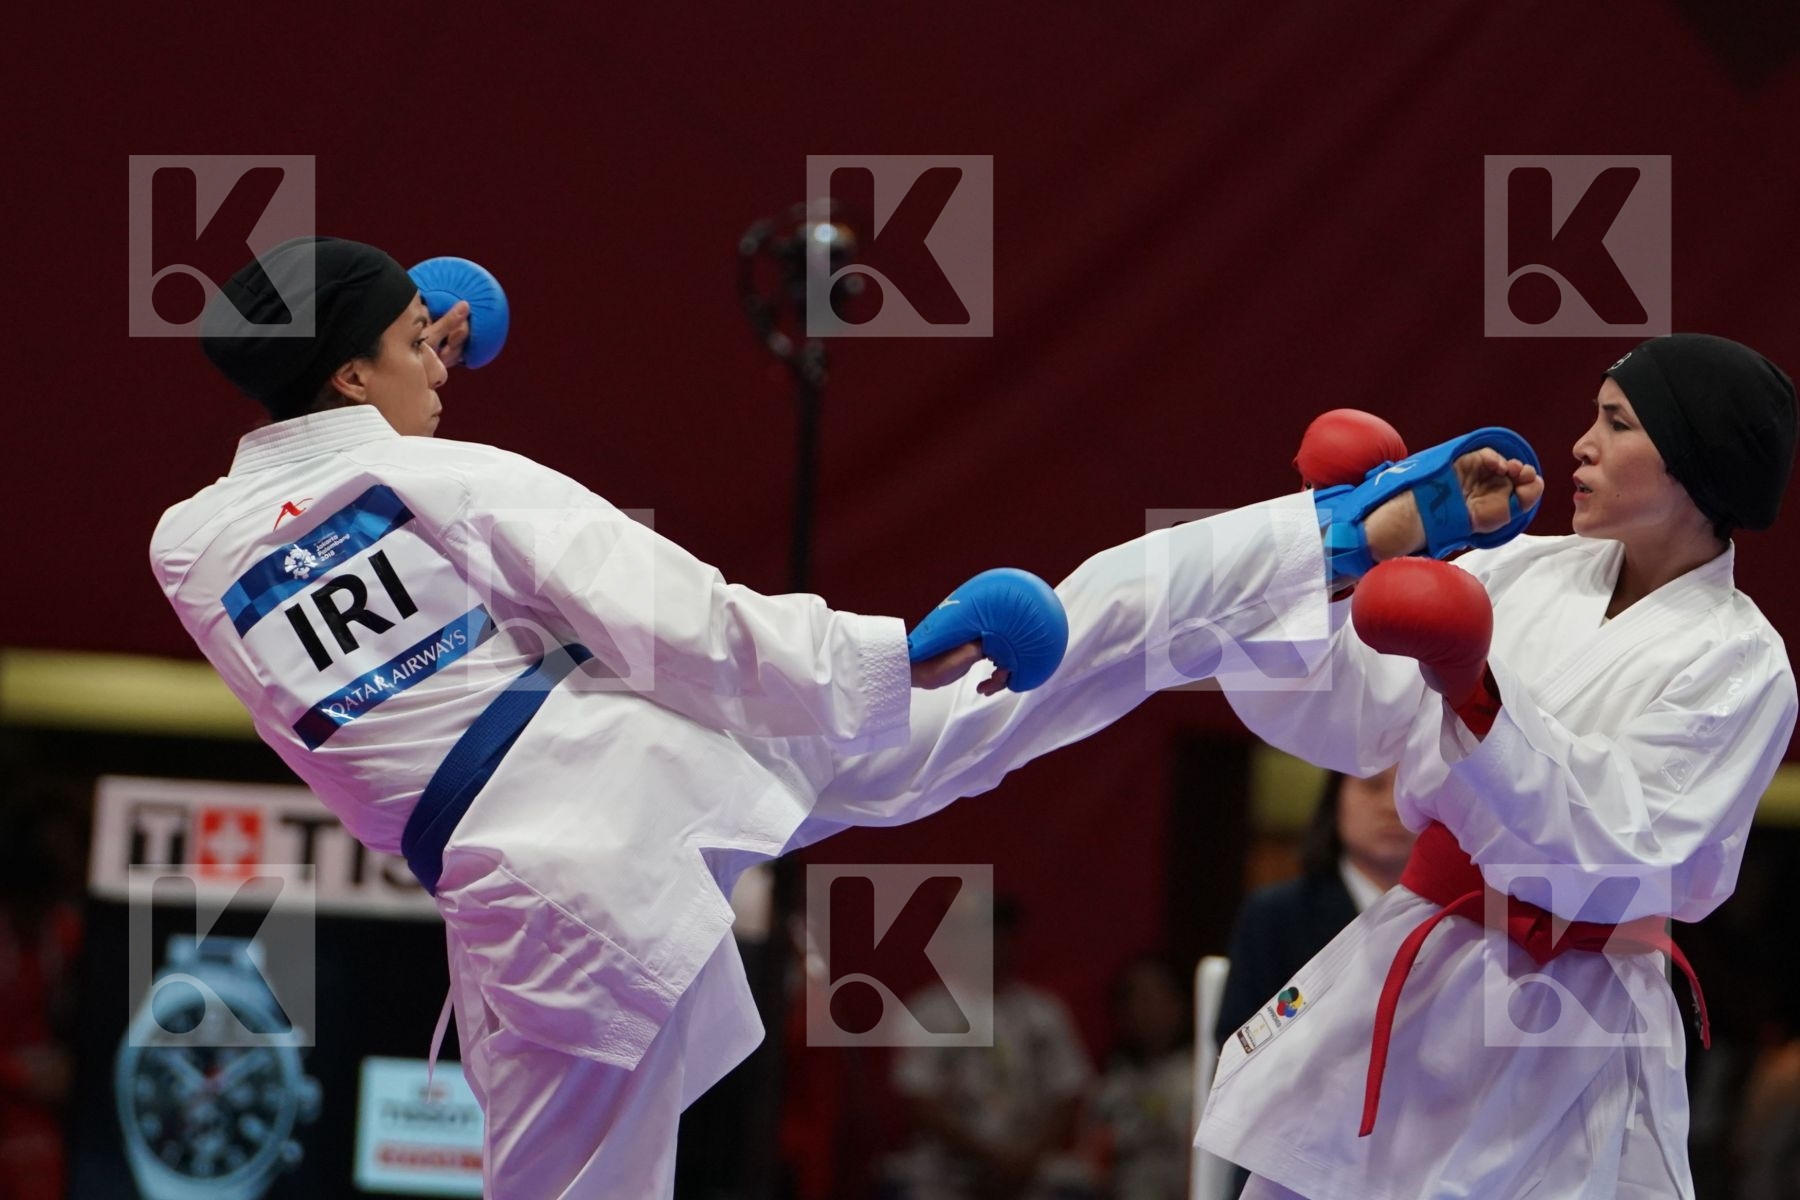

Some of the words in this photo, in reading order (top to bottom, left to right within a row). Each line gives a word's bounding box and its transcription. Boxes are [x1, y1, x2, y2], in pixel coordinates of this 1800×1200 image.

[320, 549, 336, 562] 2018
[284, 549, 419, 672] IRI
[327, 674, 393, 719] QATAR
[392, 629, 467, 685] AIRWAYS
